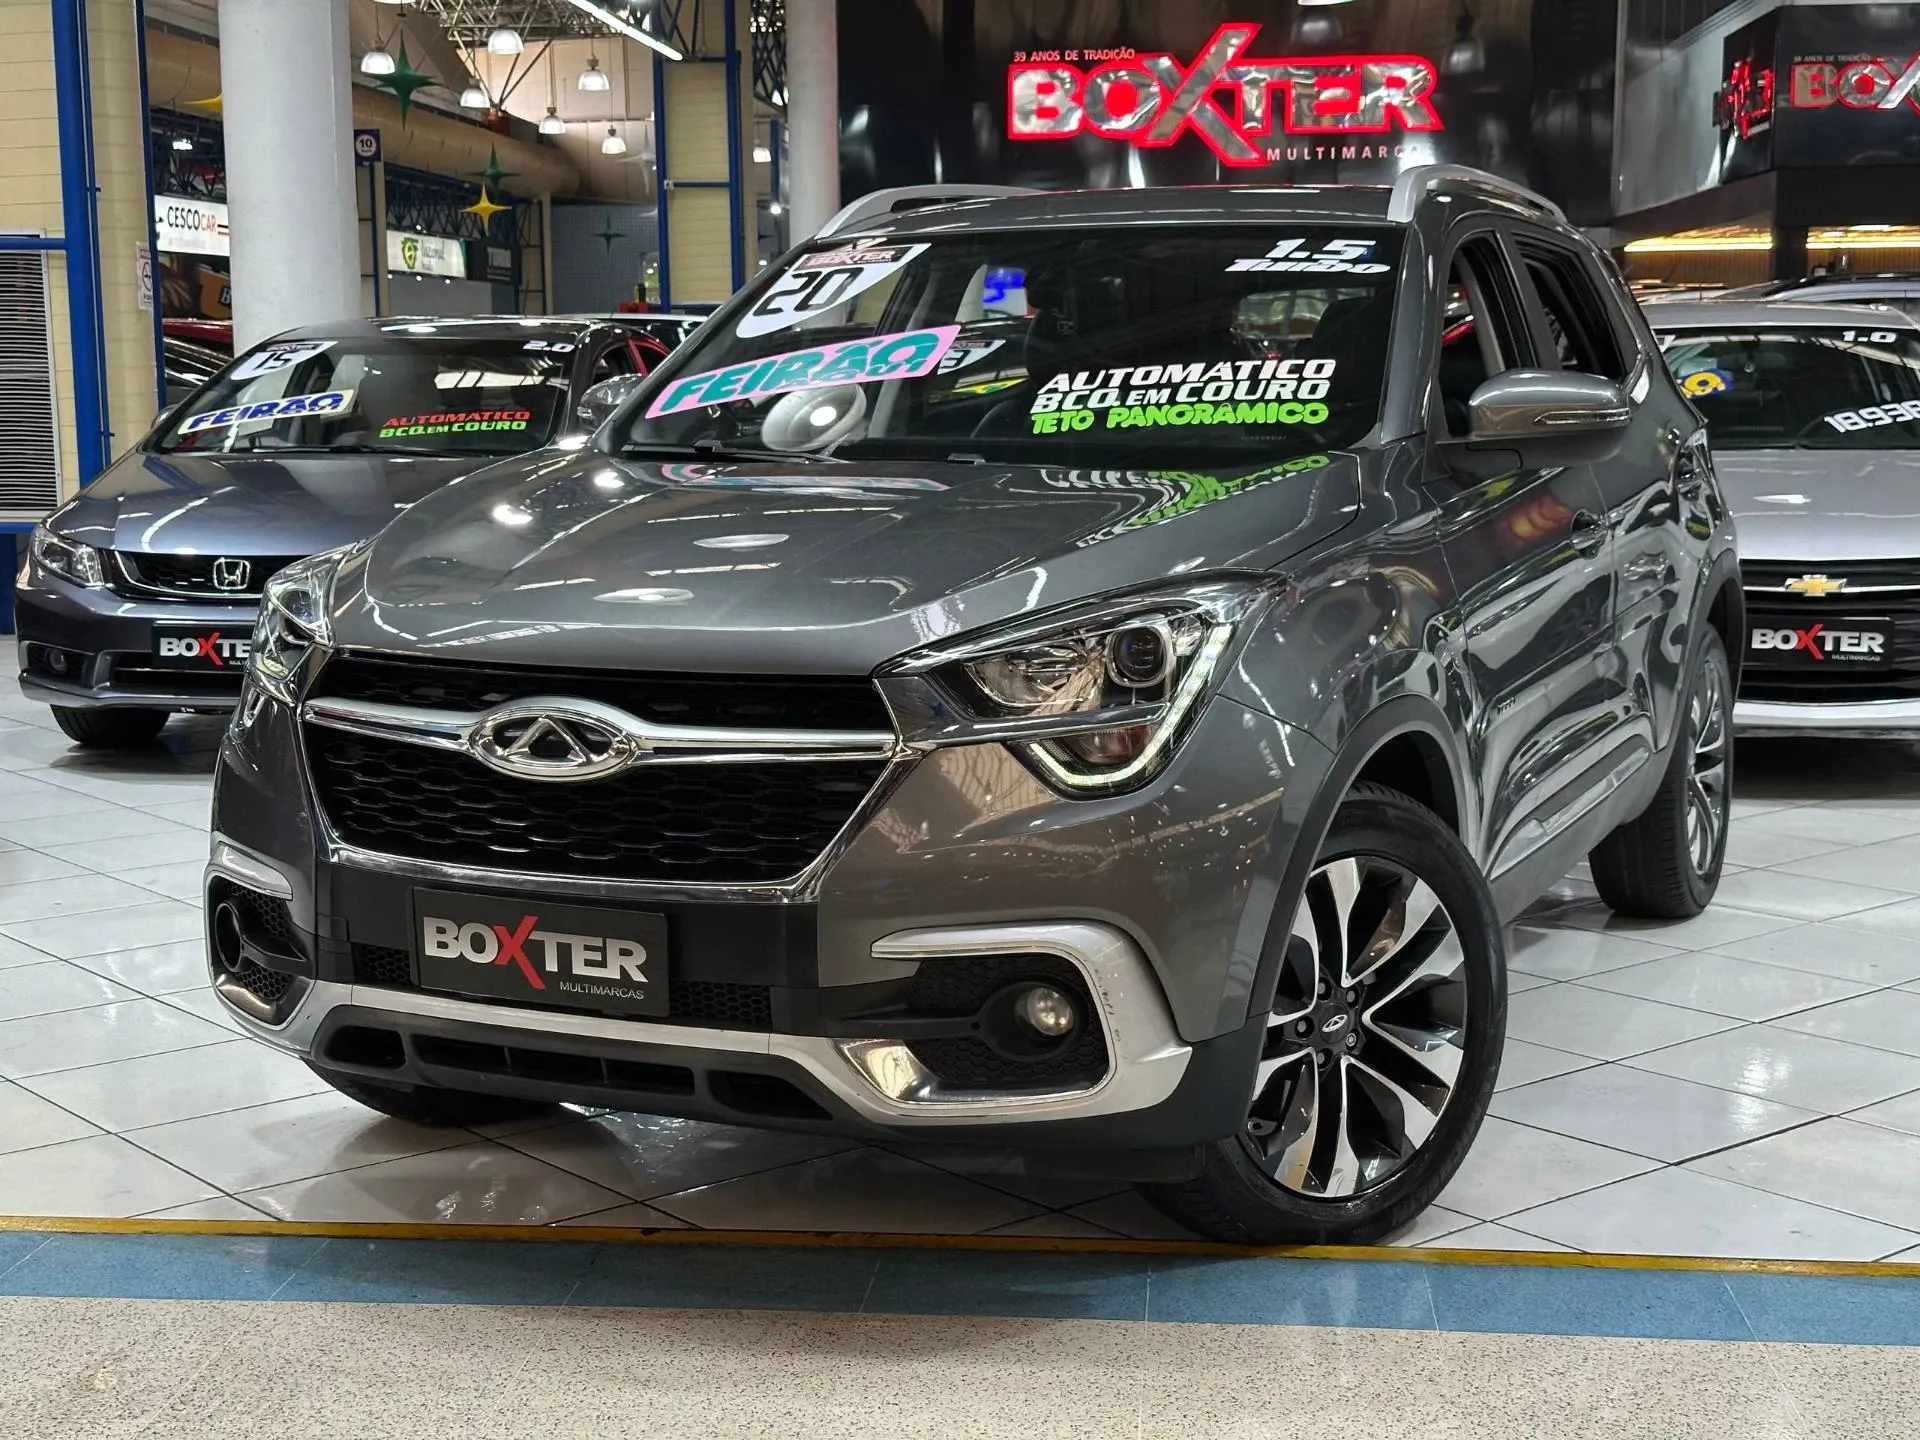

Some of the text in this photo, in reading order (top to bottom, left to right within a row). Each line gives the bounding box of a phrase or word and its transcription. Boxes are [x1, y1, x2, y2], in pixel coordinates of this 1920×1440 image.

[1013, 46, 1135, 62] 39 ANOS DE TRADIÇÃO
[1007, 23, 1446, 167] BOXTER
[359, 138, 373, 148] 10
[167, 206, 216, 232] CESCOCAR
[1265, 238, 1376, 260] 1.5
[752, 267, 865, 316] 20
[522, 340, 575, 353] 2.0
[1842, 330, 1897, 343] 1.0
[659, 332, 939, 412] FEIRÃO
[1125, 388, 1172, 406] EM
[1175, 379, 1331, 403] COURO
[187, 392, 344, 430] FEIRÃO
[1031, 409, 1095, 434] TETO
[426, 424, 449, 434] EM
[451, 421, 527, 432] COURO
[159, 632, 252, 666] BOXTE
[1751, 623, 1884, 660] BOXTER
[423, 915, 649, 990] BOXTER
[559, 980, 645, 1000] MULTIMARCAS
